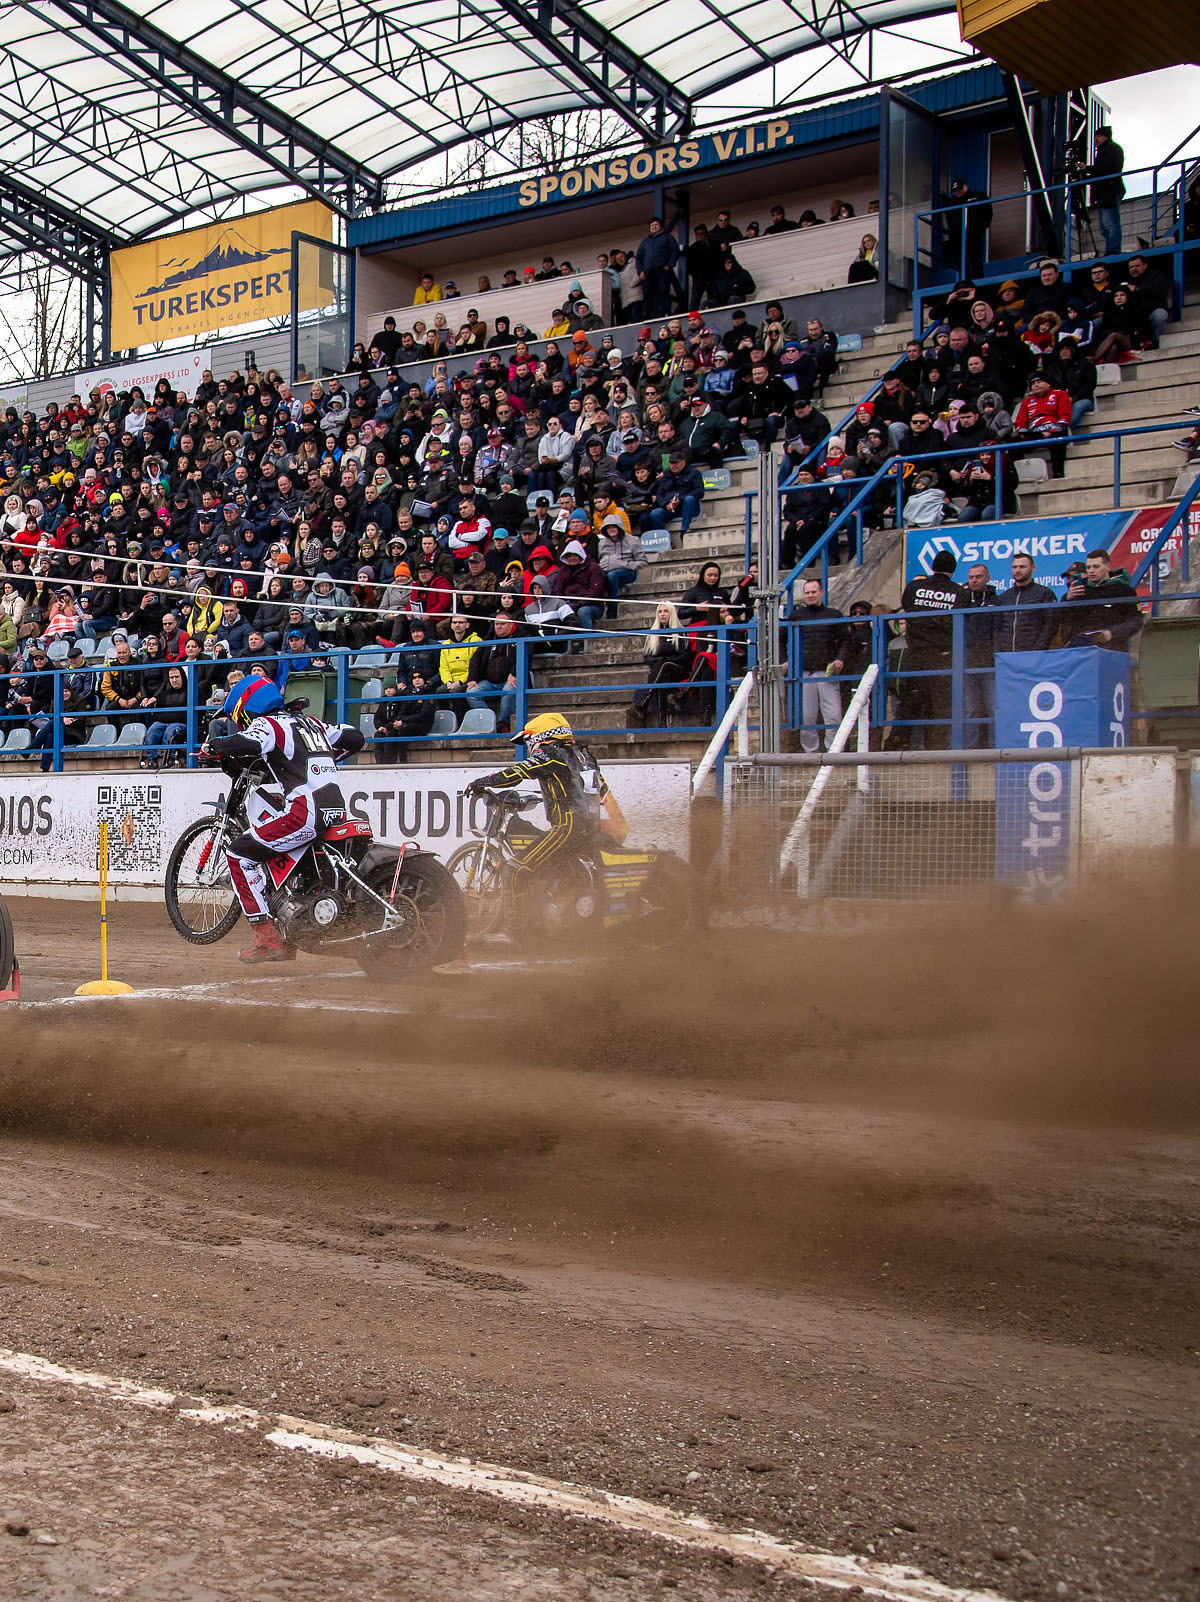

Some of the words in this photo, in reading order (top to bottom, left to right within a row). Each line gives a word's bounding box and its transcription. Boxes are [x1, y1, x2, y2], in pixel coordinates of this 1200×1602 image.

[518, 141, 701, 207] SPONSORS
[712, 120, 795, 160] V.I.P.
[133, 269, 291, 325] TUREKSPERT
[170, 320, 211, 334] TRAVEL
[220, 307, 266, 322] AGENCY
[177, 368, 190, 377] LTD
[962, 533, 1087, 562] STOKKER
[913, 599, 954, 609] SECURITY
[915, 588, 957, 602] GROM
[297, 727, 329, 752] 14
[1020, 681, 1063, 858] trodo
[349, 790, 492, 839] STUDIO
